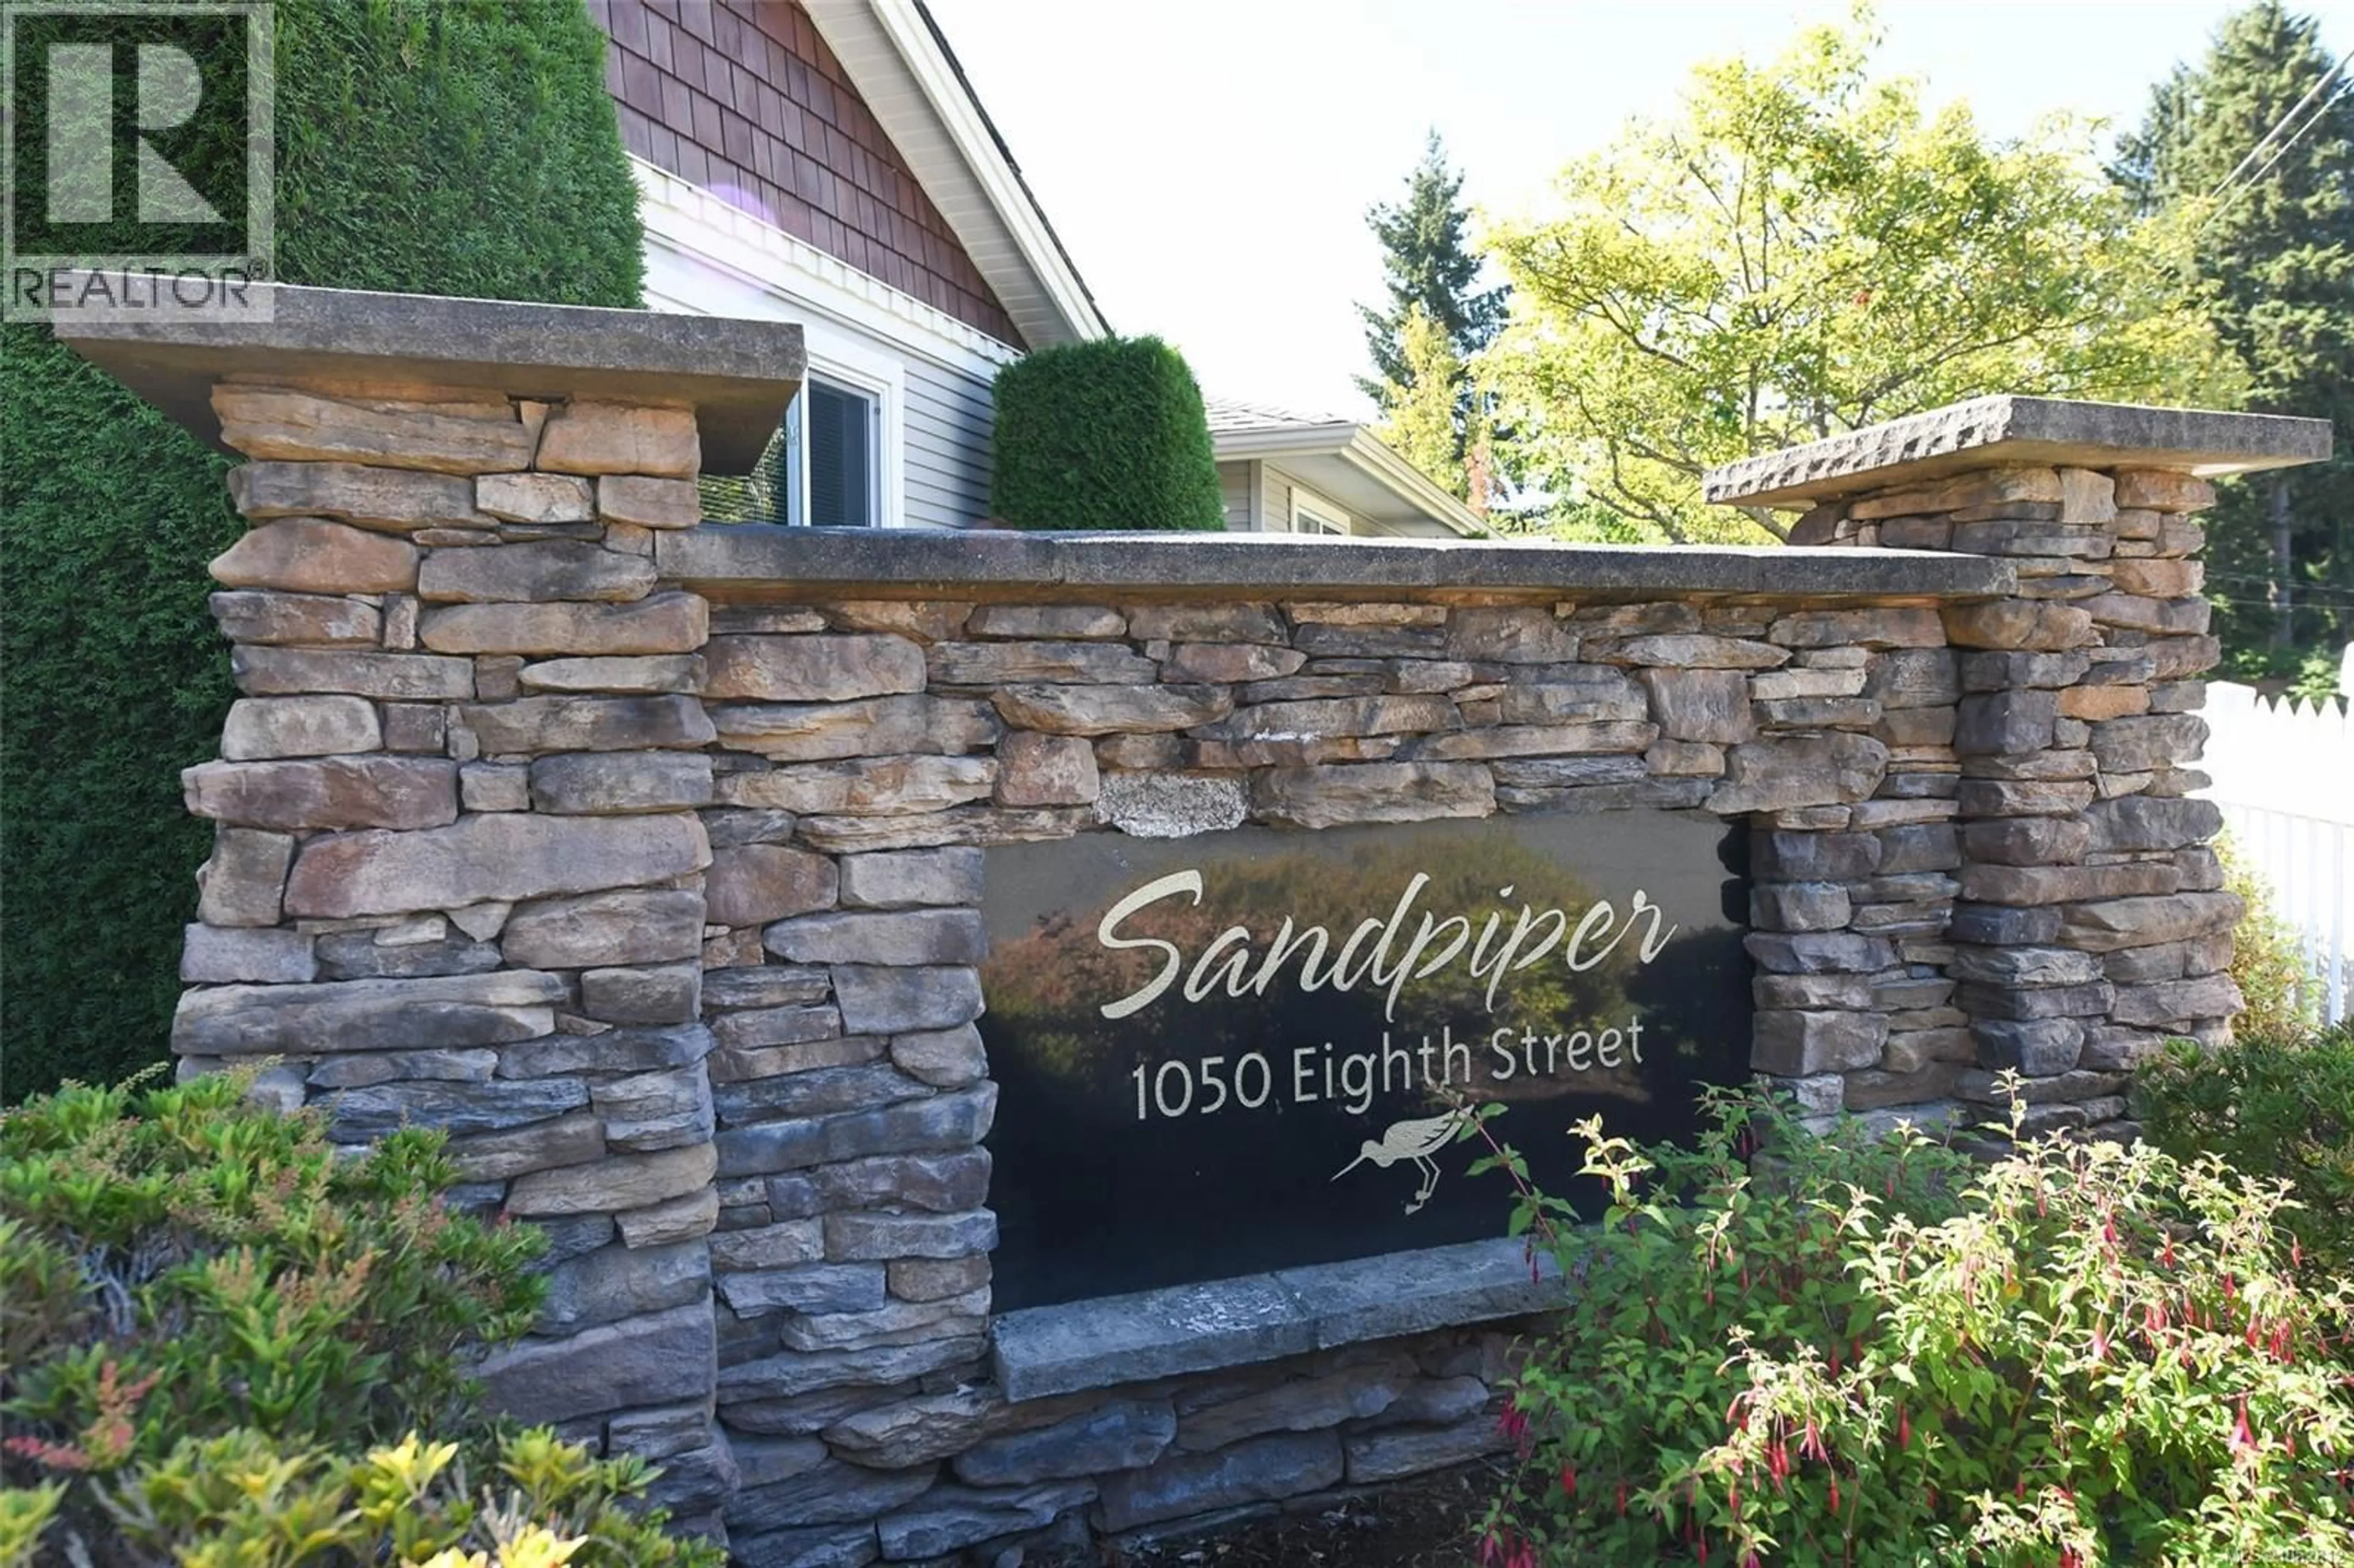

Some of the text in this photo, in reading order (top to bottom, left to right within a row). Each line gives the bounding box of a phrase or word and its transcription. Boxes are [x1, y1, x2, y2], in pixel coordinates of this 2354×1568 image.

[1097, 868, 1679, 1024] Sandpiper
[1131, 1014, 1645, 1121] 1050 Eighth Street
